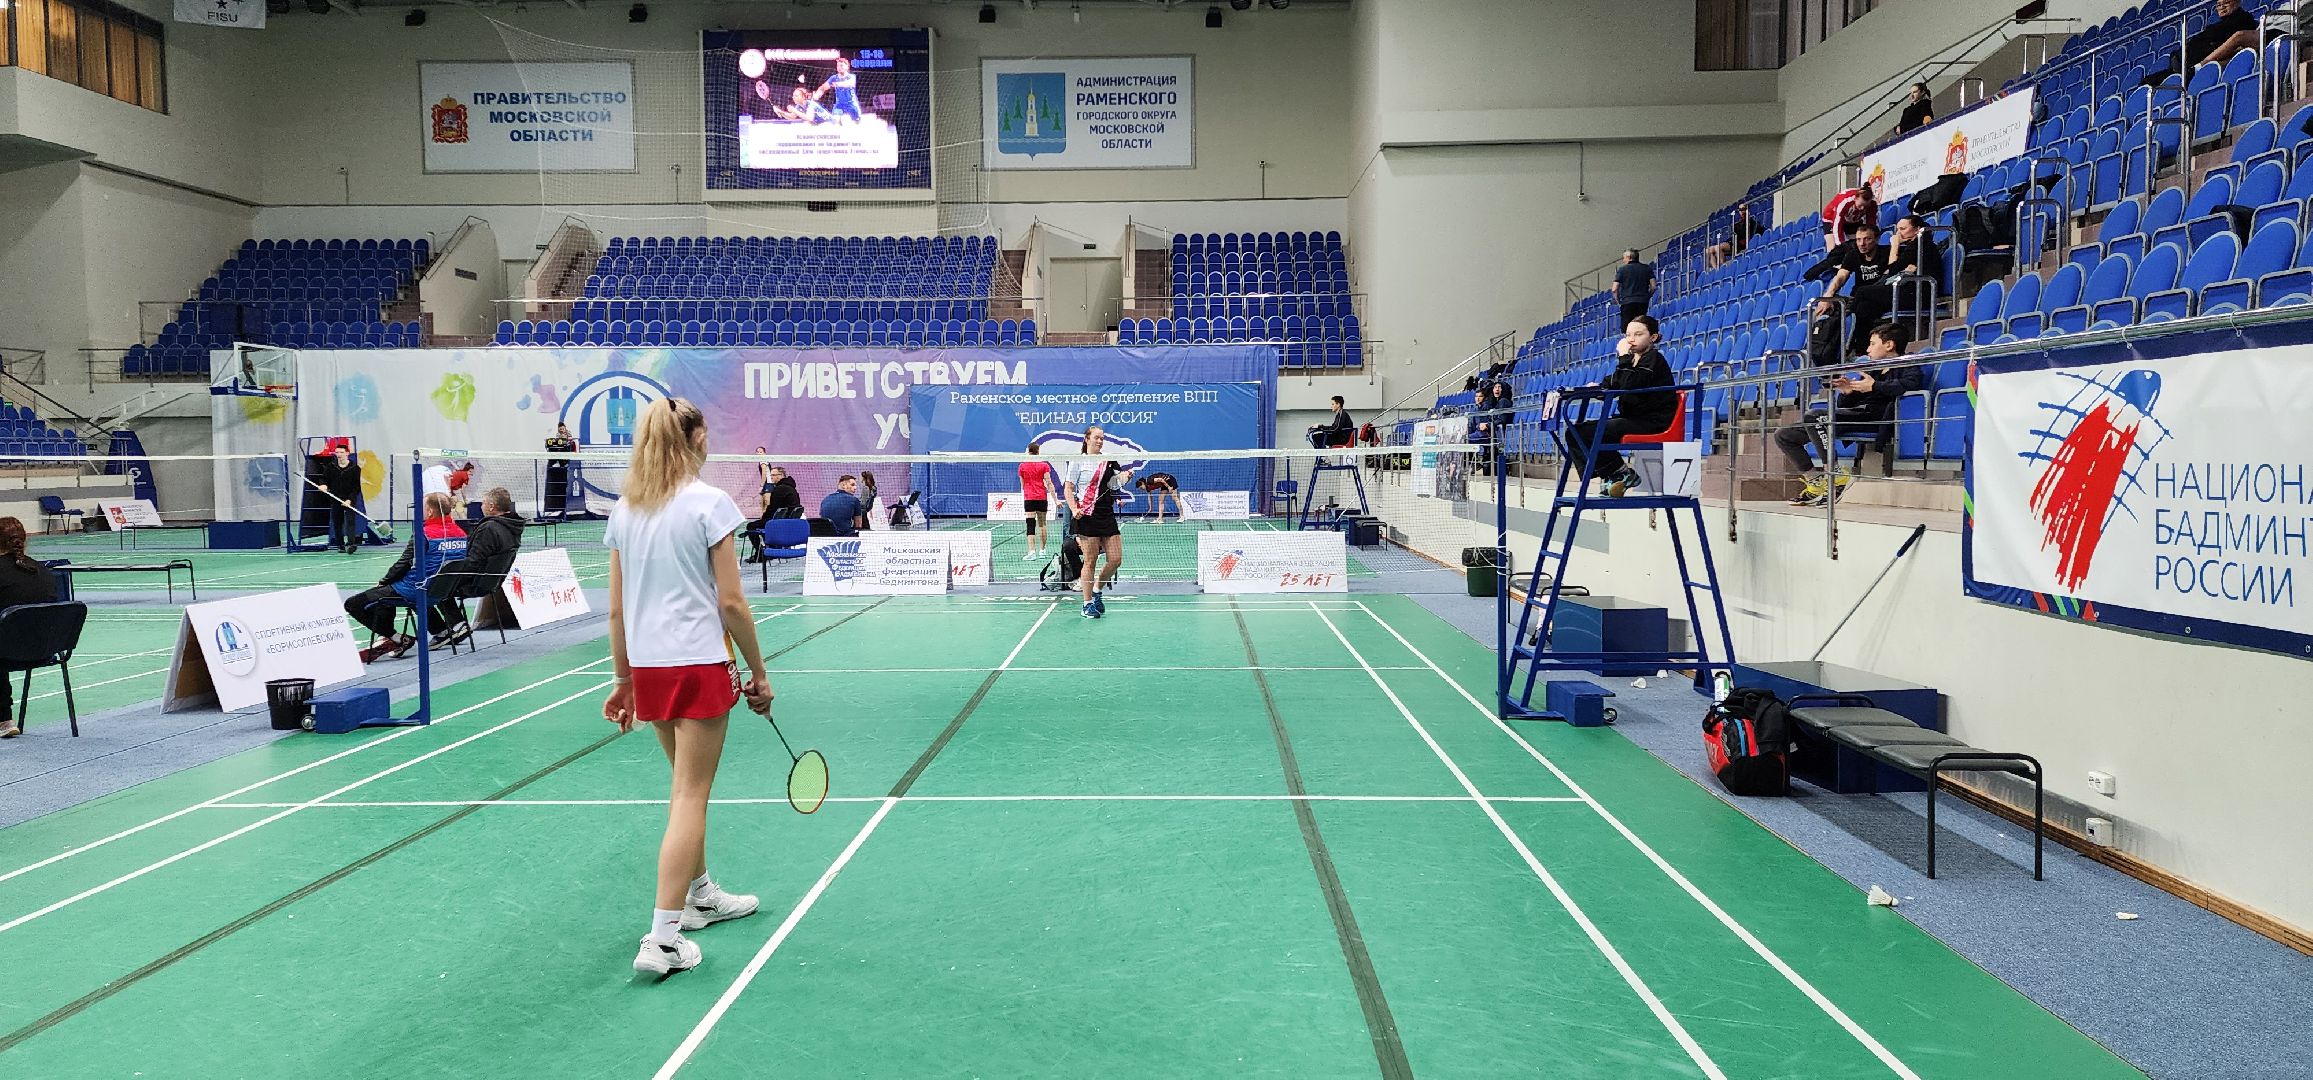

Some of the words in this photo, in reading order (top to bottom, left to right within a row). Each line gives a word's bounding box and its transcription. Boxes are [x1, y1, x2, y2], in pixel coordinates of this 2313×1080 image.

[207, 11, 239, 22] FISU
[1076, 75, 1177, 88] АДМИНИСТРАЦИЯ
[473, 92, 627, 105] ПРАВИТЕЛЬСТВО
[1076, 91, 1177, 106] РАМЕНСКОГО
[489, 107, 612, 124] МОСКОВСКОЙ
[1076, 110, 1139, 121] ГОРОДСКОГО
[1141, 110, 1177, 120] ОКРУГА
[1089, 121, 1165, 134] МОСКОВСКОЙ
[510, 129, 593, 142] ОБЛАСТИ
[1101, 138, 1152, 149] ОБЛАСТИ
[744, 360, 1028, 399] ПРИВЕТСТВУЕМ
[950, 391, 1032, 404] Раменское
[1035, 393, 1098, 404] местное
[1101, 392, 1180, 405] отделение
[1184, 390, 1218, 403] ВПП
[1015, 411, 1086, 426] "ЕДИНАЯ
[1090, 411, 1158, 424] РОССИЯ"
[1670, 458, 1694, 494] 7
[2155, 462, 2313, 508] НАЦИОН
[2155, 508, 2313, 557] БАДМИН
[1280, 572, 1302, 587] 25
[1303, 573, 1338, 587] ЛЕТ
[2155, 555, 2294, 607] РОССИИ
[255, 621, 307, 640] СПОРТИВНЫЙ
[308, 615, 344, 630] КОМПЛЕКС
